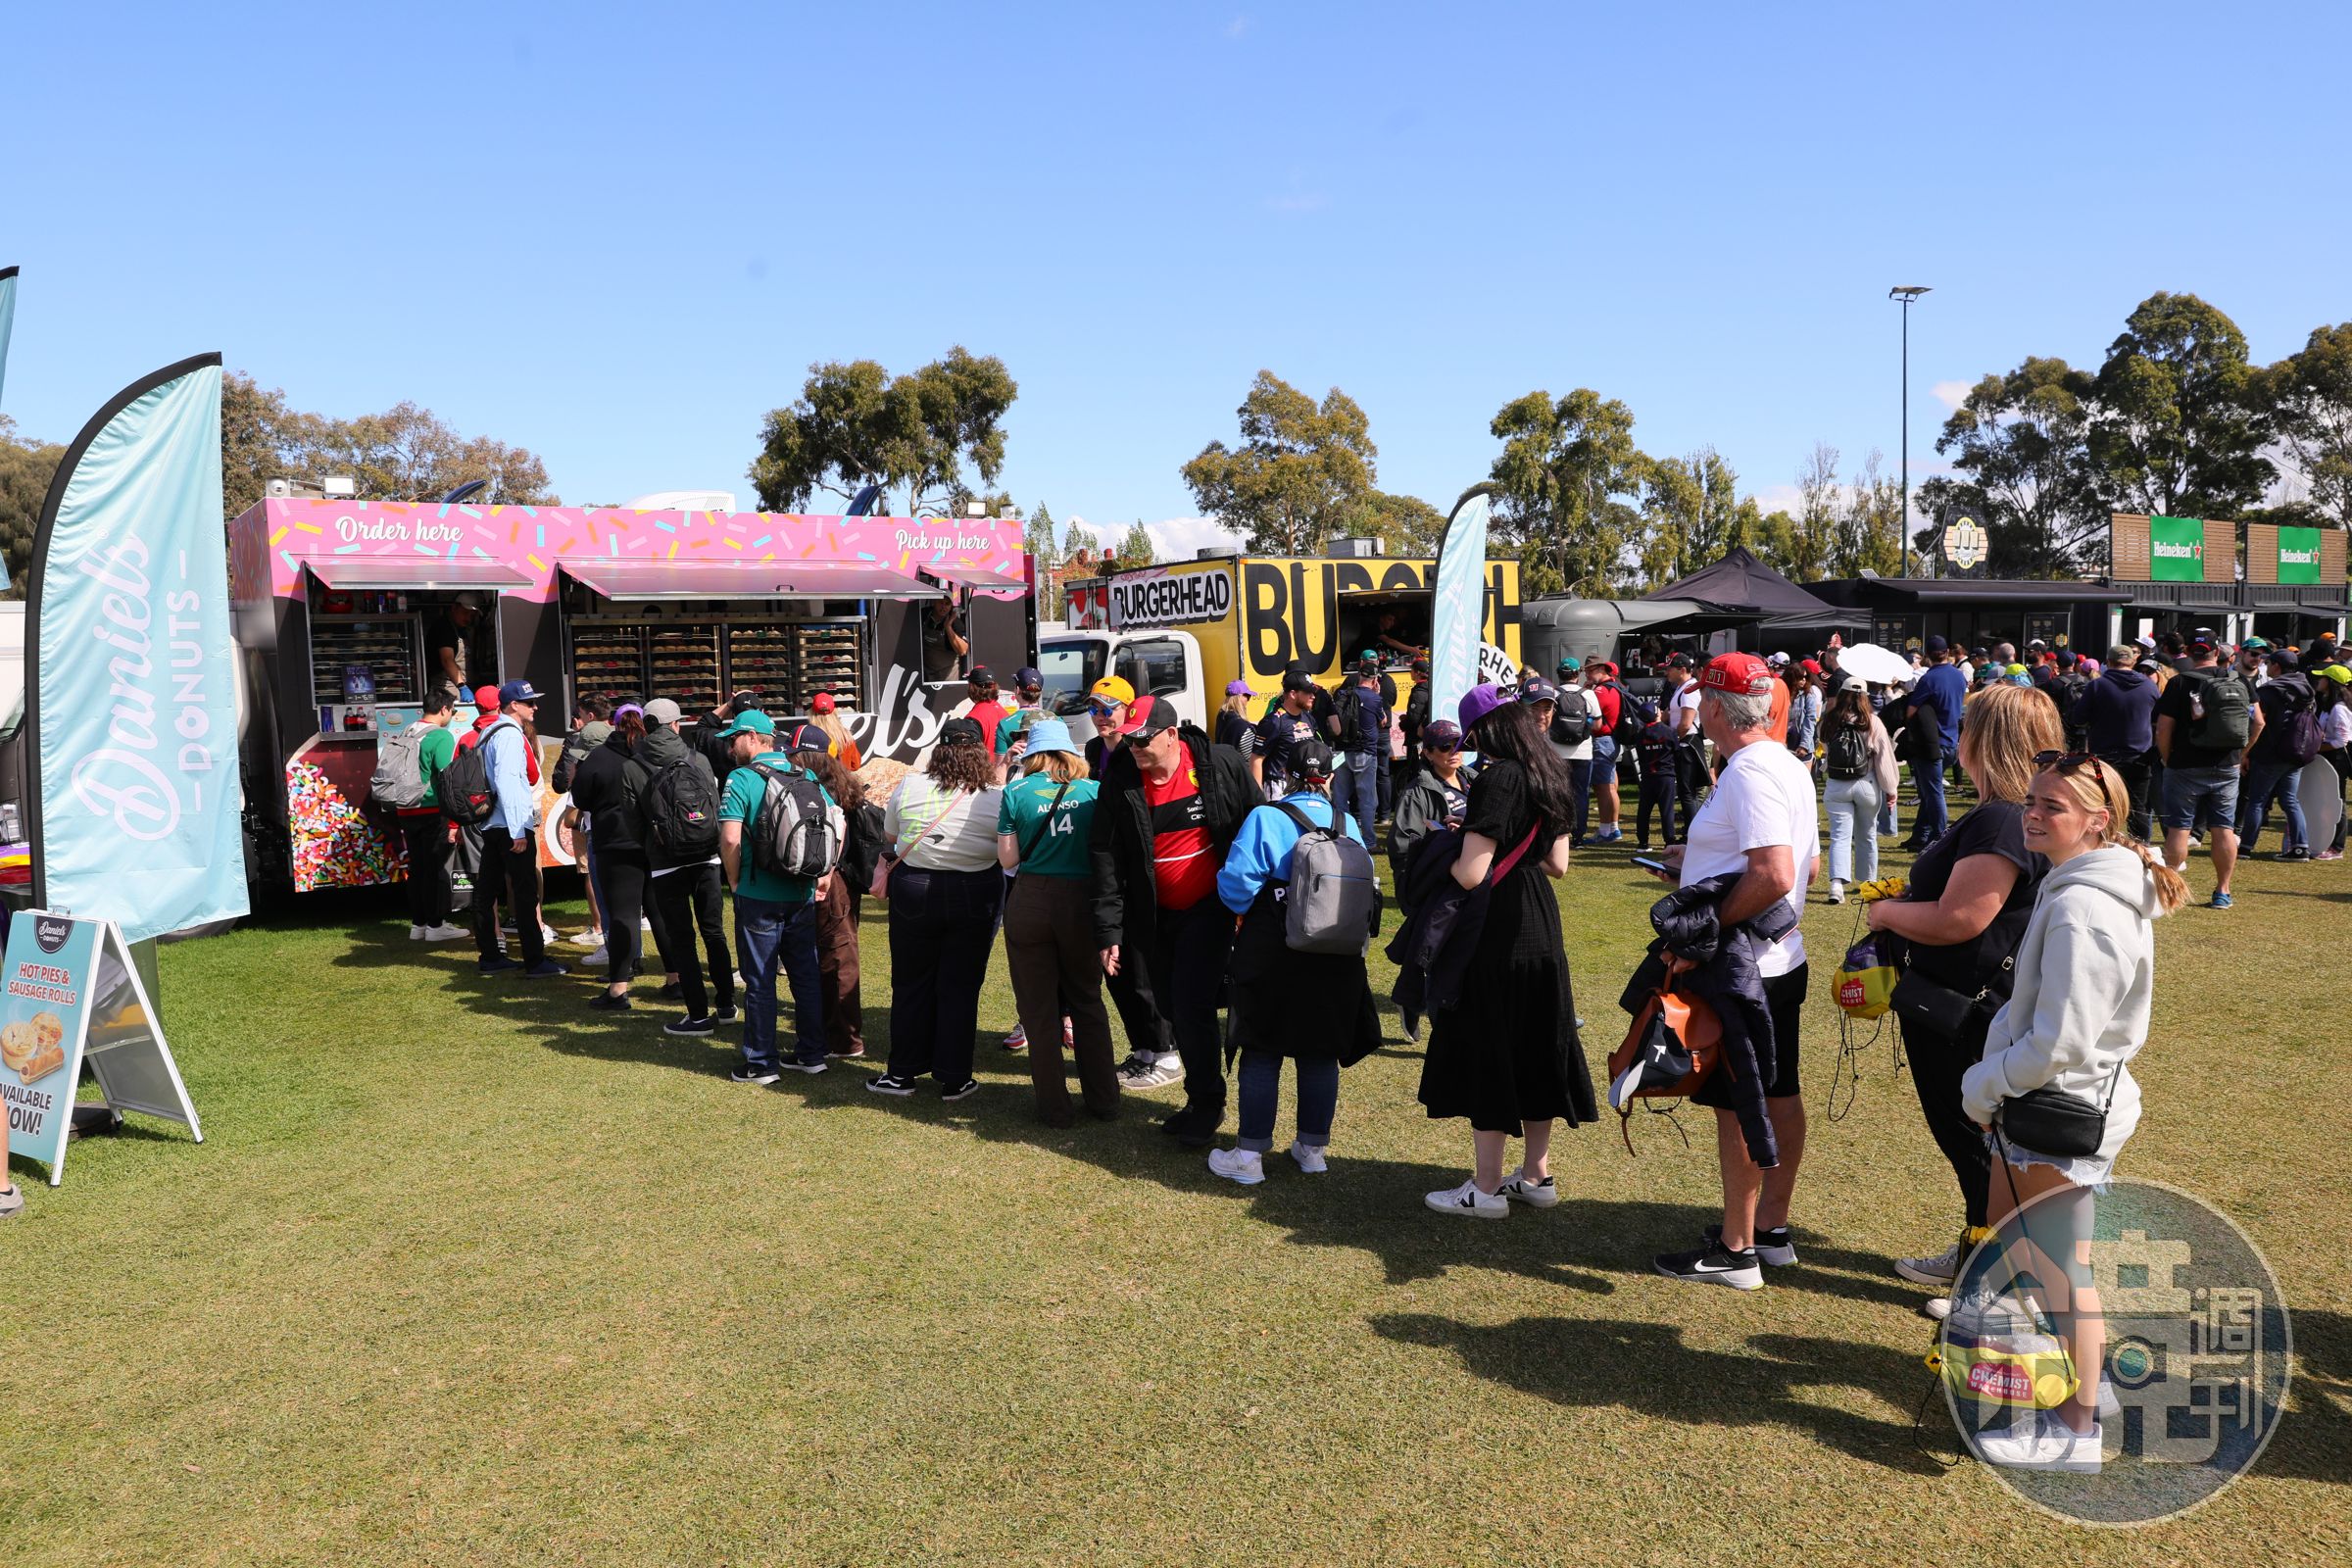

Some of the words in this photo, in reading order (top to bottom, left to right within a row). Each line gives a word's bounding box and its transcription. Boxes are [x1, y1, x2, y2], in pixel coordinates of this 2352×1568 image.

[335, 515, 411, 542] Order
[416, 517, 464, 542] here
[895, 529, 931, 552] Pick
[934, 536, 955, 558] up
[957, 530, 991, 550] here
[2153, 541, 2192, 559] Heineken
[2279, 549, 2312, 563] Heineken
[1113, 572, 1230, 620] BURGERHEAD
[166, 590, 213, 770] DONUTS
[1050, 812, 1074, 837] 14
[20, 963, 39, 978] HOT
[40, 966, 60, 983] PIES
[62, 970, 70, 984] &
[9, 981, 47, 1000] SAUSAGE
[48, 988, 75, 1004] ROLLS
[8, 1105, 42, 1135] OW!
[1970, 1381, 2028, 1398] WAREHOUSE
[1972, 1368, 2030, 1391] CHEMIST
